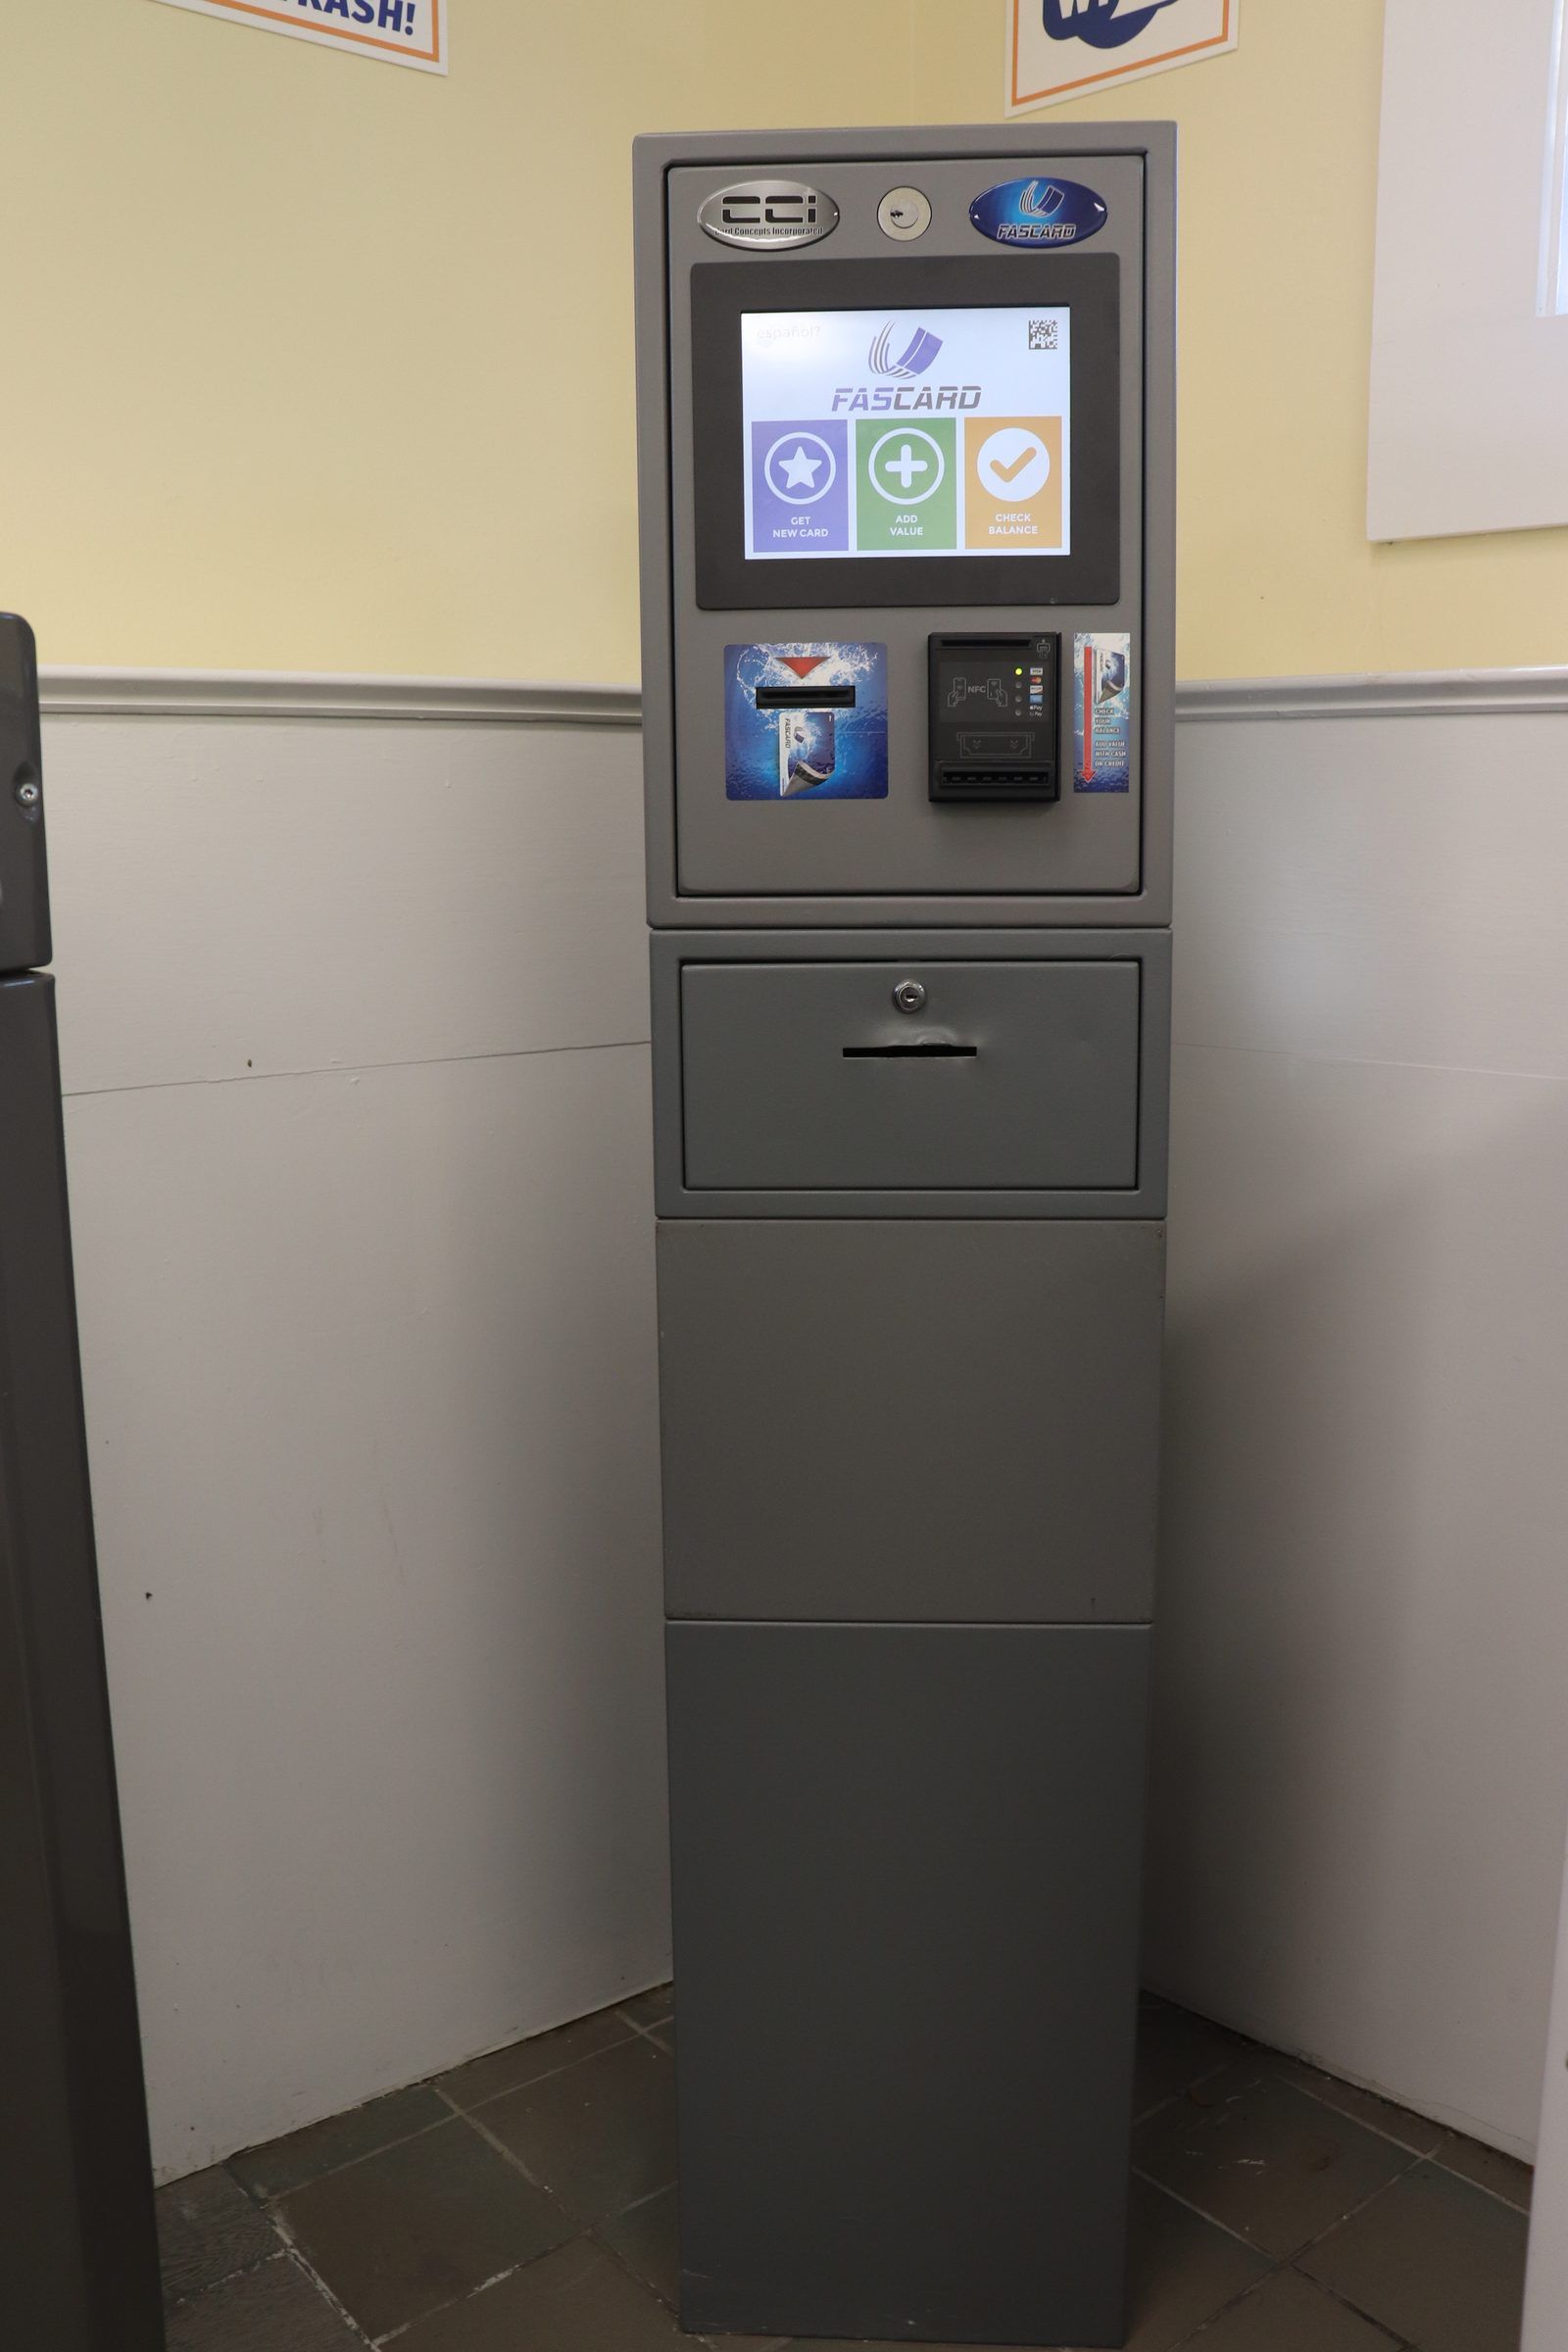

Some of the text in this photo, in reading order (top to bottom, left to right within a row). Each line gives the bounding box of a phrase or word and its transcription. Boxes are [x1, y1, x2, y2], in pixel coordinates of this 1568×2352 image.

[772, 226, 823, 235] Incorporated
[998, 223, 1076, 239] FASCARD
[757, 324, 821, 340] español?
[831, 386, 981, 412] FASCARD
[791, 516, 811, 525] GET
[896, 514, 918, 523] ADD
[995, 514, 1031, 522] CHECK
[772, 528, 829, 538] NEW CARD
[890, 527, 923, 536] VALUE
[988, 525, 1039, 535] BALANCE
